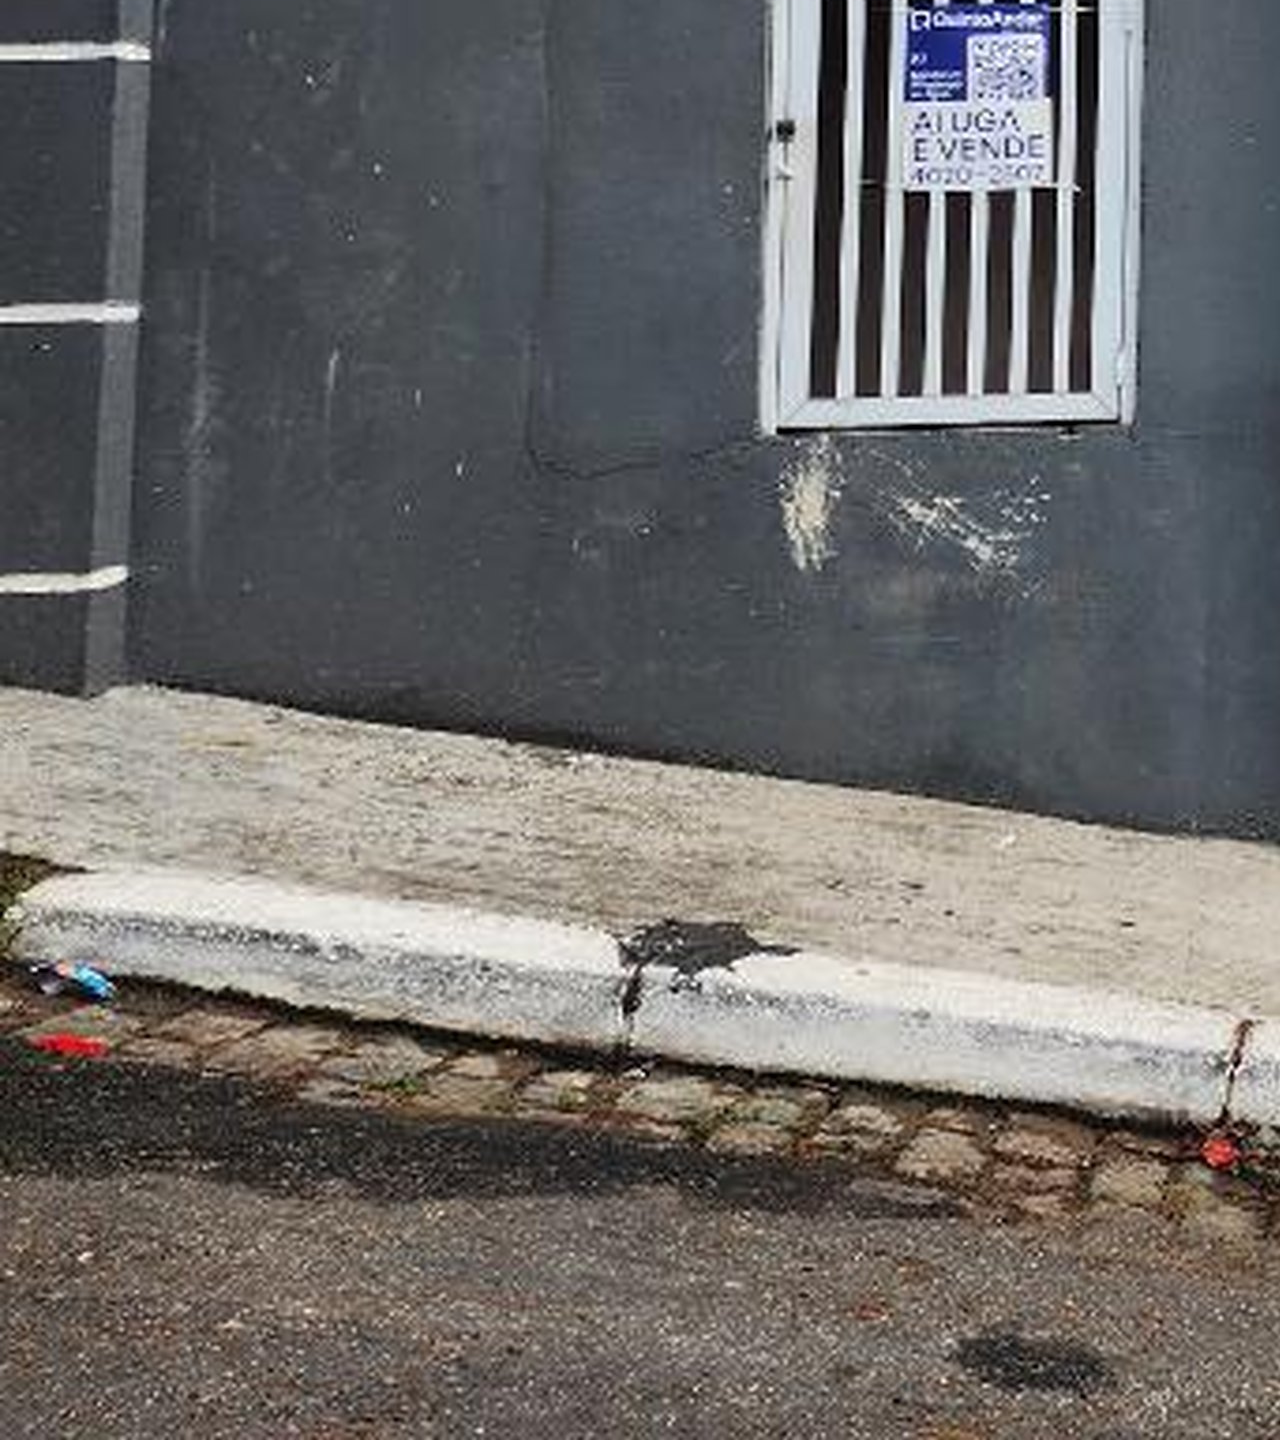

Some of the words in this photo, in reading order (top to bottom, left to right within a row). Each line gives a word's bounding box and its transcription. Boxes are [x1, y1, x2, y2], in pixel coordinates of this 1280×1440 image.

[914, 109, 1022, 133] ALUGA
[914, 138, 930, 161] E
[937, 134, 1045, 160] VENDE
